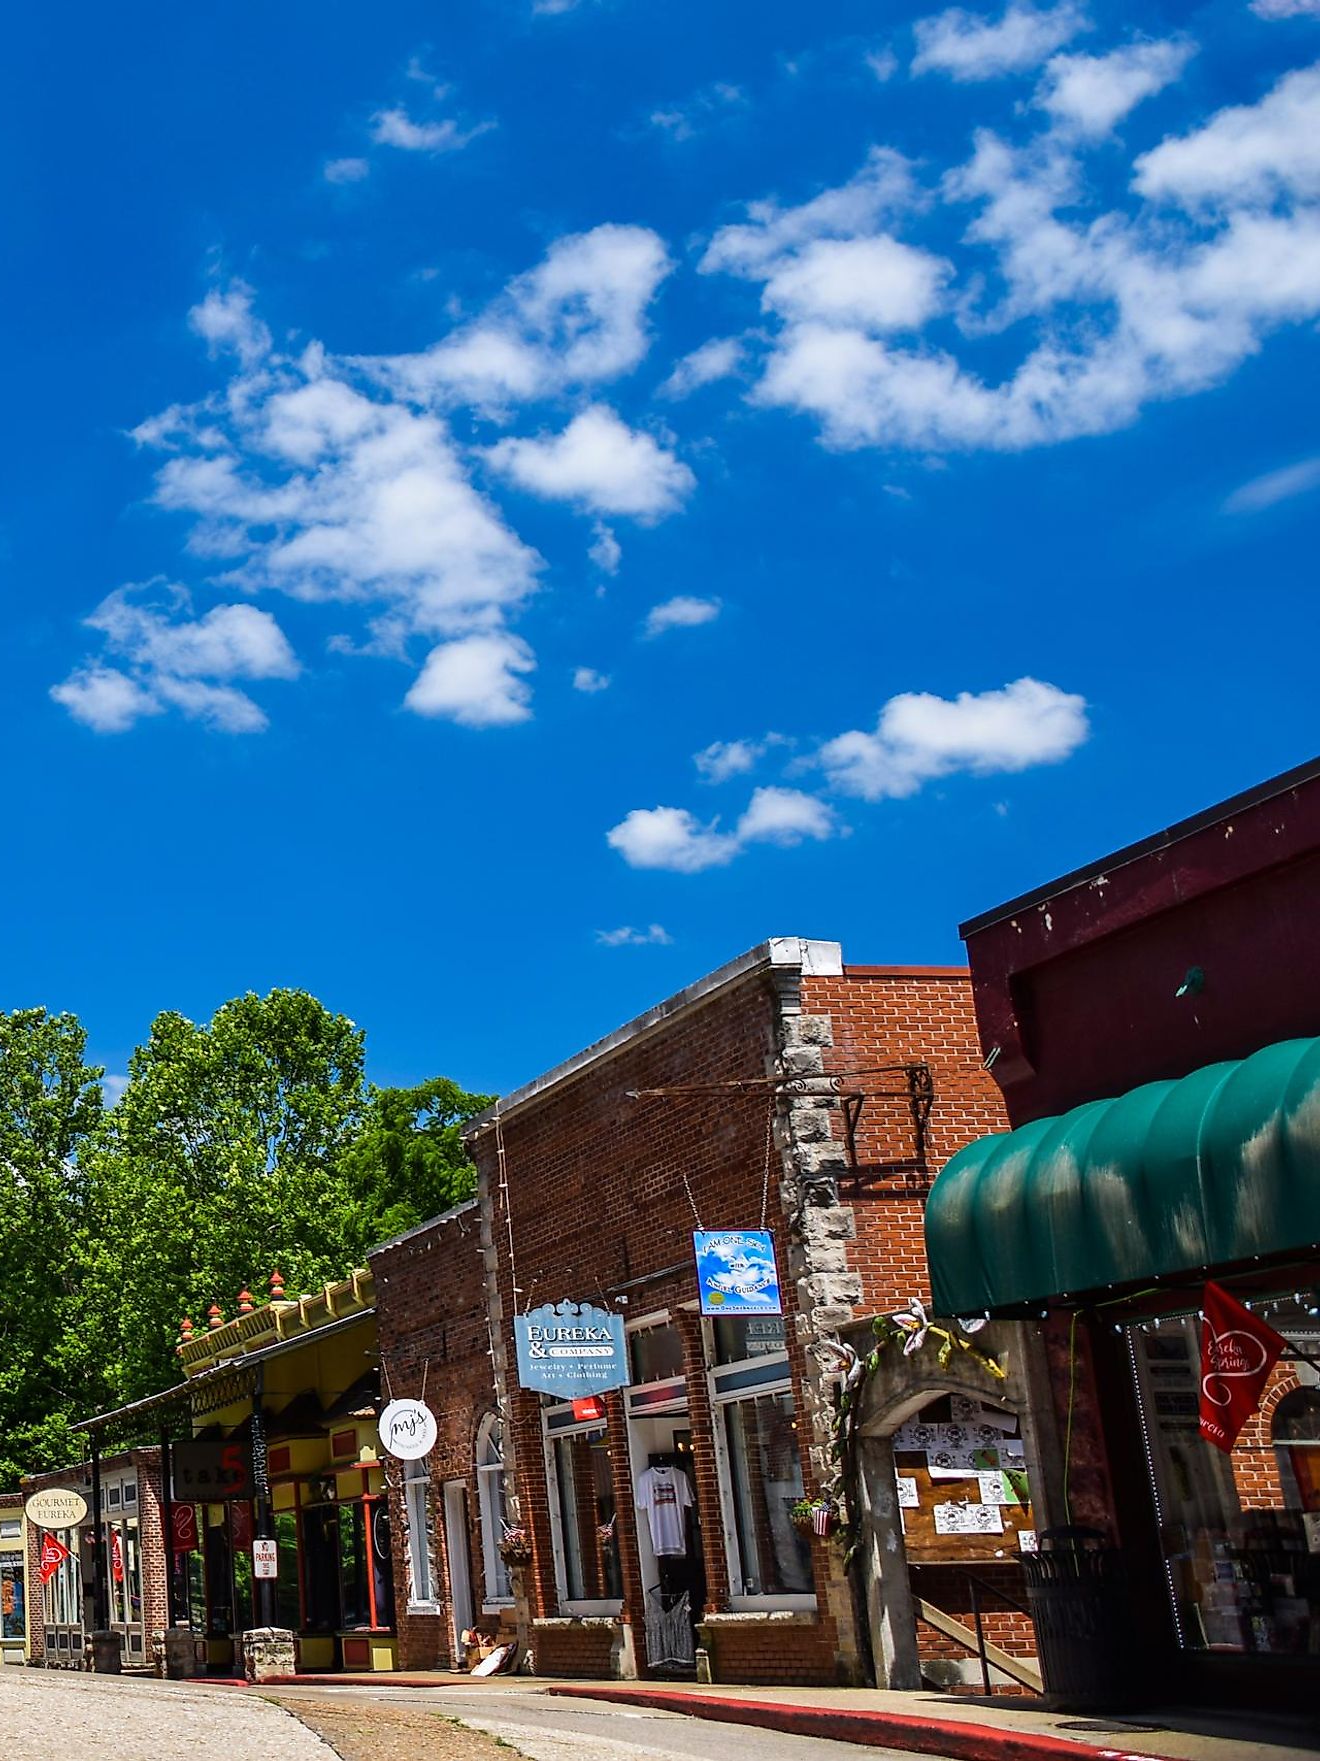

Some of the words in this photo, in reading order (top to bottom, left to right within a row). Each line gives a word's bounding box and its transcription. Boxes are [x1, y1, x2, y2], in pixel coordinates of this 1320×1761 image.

[528, 1326, 614, 1341] EUREKA
[528, 1341, 550, 1359] &
[551, 1347, 611, 1355] COMPANY
[530, 1363, 565, 1372] Jewelry
[577, 1362, 617, 1370] Perfume
[222, 1444, 248, 1494] 5
[32, 1498, 80, 1508] GOURMET
[38, 1510, 77, 1519] EUREKA
[255, 1552, 276, 1562] PARKING
